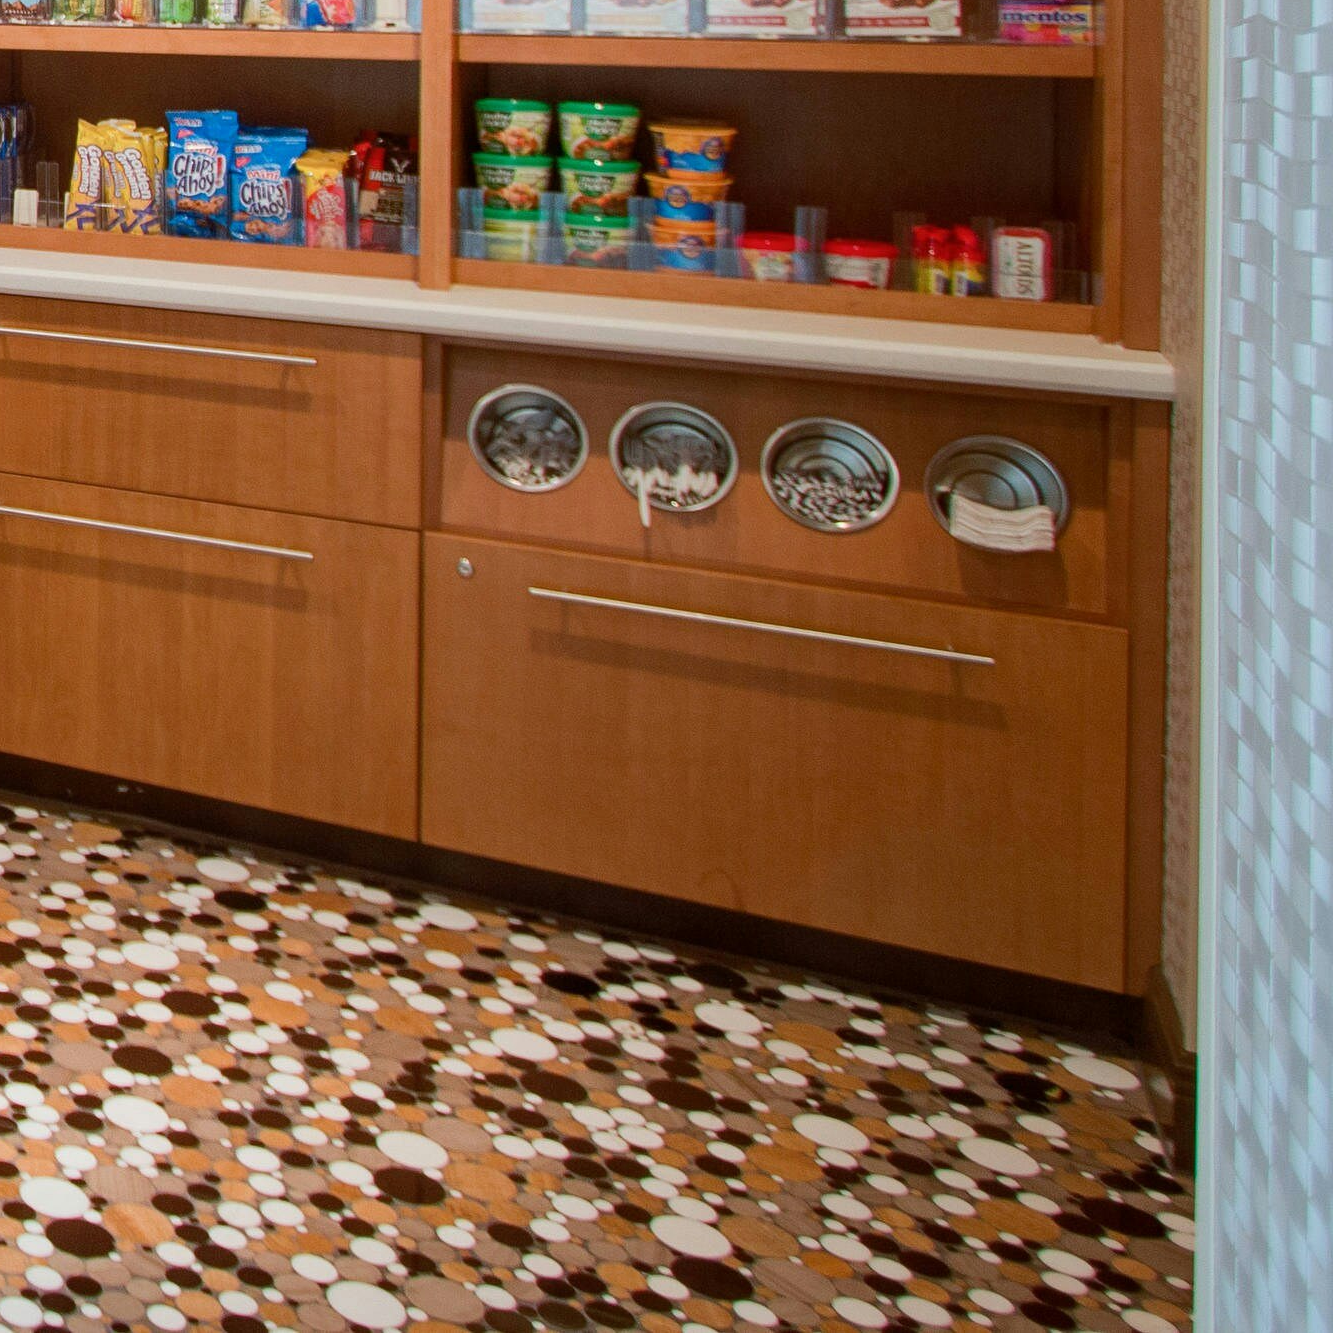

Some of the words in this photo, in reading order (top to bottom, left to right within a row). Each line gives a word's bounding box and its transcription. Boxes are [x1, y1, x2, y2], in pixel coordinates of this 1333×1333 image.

[1001, 9, 1087, 24] mentos
[124, 147, 153, 200] Golden
[174, 153, 215, 178] Chips
[240, 179, 283, 204] Chips
